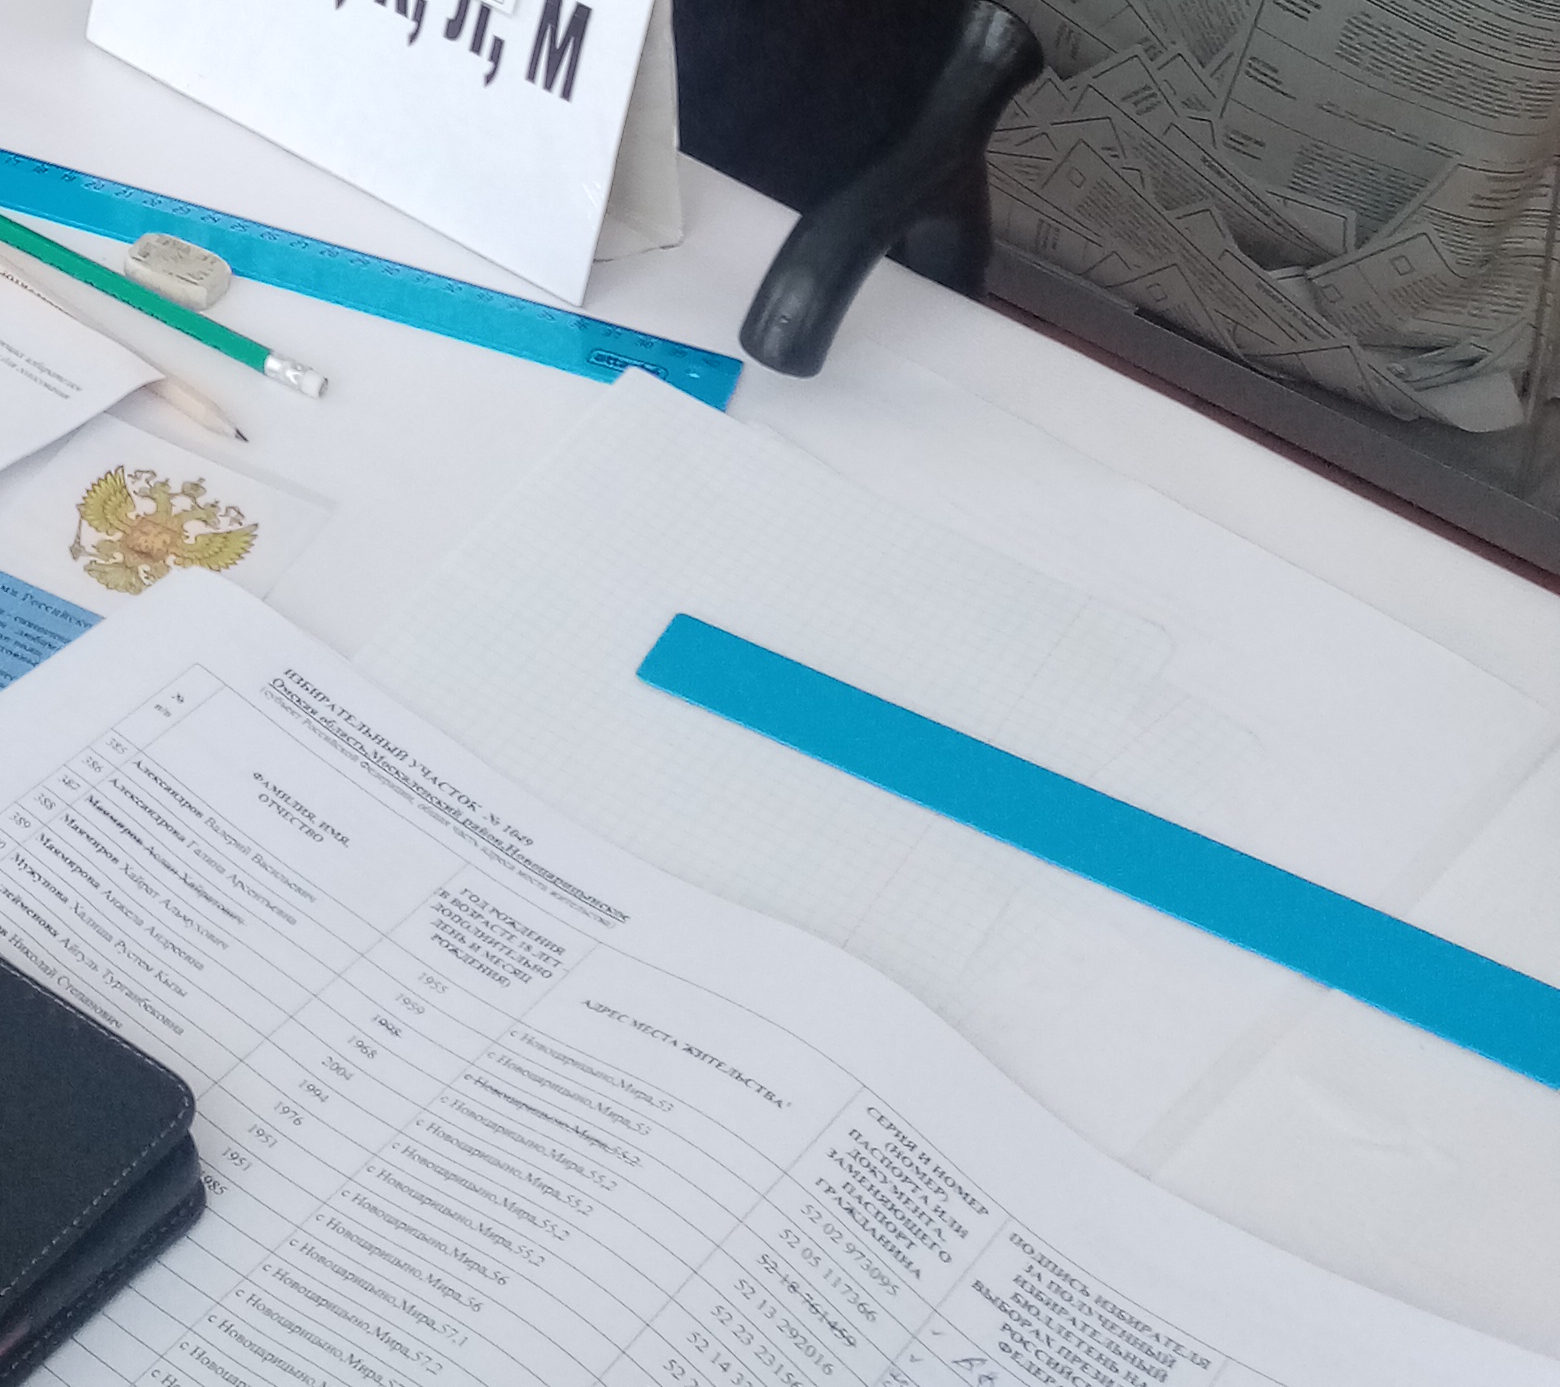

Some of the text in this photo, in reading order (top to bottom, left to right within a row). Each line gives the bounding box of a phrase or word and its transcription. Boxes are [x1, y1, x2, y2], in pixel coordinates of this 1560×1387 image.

[283, 669, 409, 761] ИЗБИРАТЕЛЬНЫЙ
[408, 759, 482, 813] УЧАСТОК
[252, 771, 351, 849] ФАМИЛИЯ, ИМЯ,
[257, 794, 324, 843] ОТЧЕСТВО
[431, 902, 553, 979] ДОПОЛНИТЕЛЬНО
[431, 918, 467, 944] ДЕНЬ
[483, 950, 533, 984] МЕСЯЦ
[450, 896, 518, 942] ВОЗРАСТЕ
[460, 888, 566, 956] ГОД РОЖДЕНИЯ
[581, 998, 628, 1024] АДРЕС
[630, 1018, 679, 1048] МЕСТА
[847, 1128, 970, 1240] ПАСПОРТА ИЛИ
[866, 1106, 990, 1217] СЕРИЯ И НОМЕР
[884, 1141, 950, 1203] (НОМЕР)
[814, 1177, 923, 1281] ГРАЖДАНИНА
[825, 1148, 953, 1265] ЗАМЕНЯЮЩЕГО
[840, 1181, 918, 1252] ПАСПОРТ
[971, 1279, 1055, 1349] ВЫБОРАХ
[1009, 1232, 1213, 1371] ПОДПИСЬ ИЗБИРАТЕЛЯ
[1010, 1292, 1149, 1387] БЮЛЛЕТЕНЬ НА
[1013, 1274, 1169, 1384] ИЗБИРАТЕЛЬНЫЙ
[1023, 1261, 1177, 1369] ЗА ПОЛУЧЕННЫЙ
